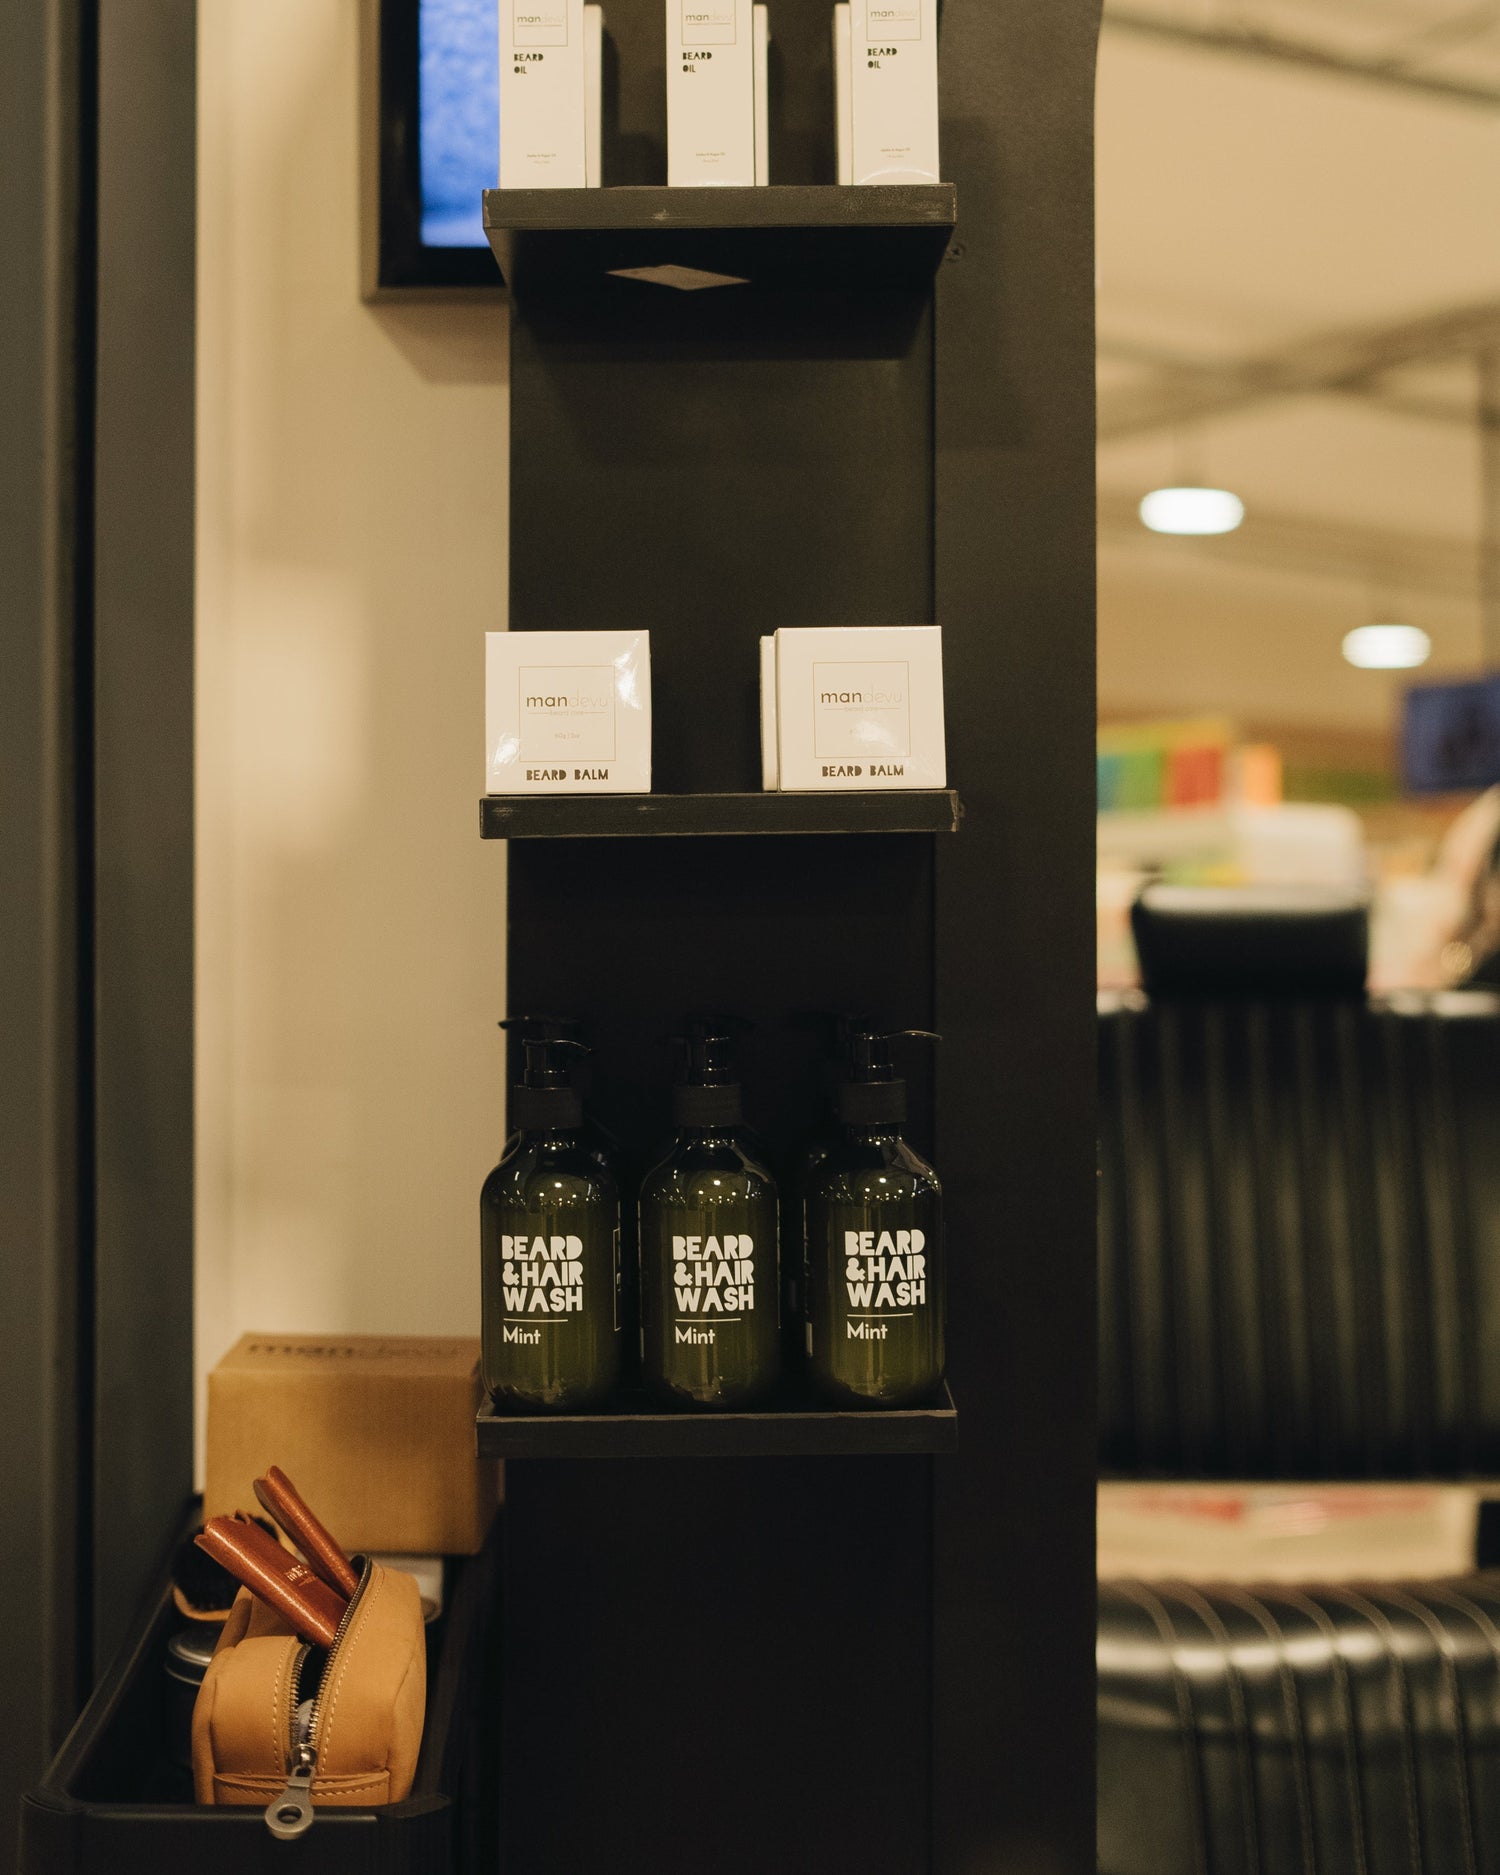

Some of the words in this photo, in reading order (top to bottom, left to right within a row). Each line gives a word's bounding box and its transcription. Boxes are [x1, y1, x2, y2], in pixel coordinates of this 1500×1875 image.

[513, 53, 544, 62] BEARD
[682, 51, 713, 61] BEARD
[868, 47, 898, 57] BEARD
[513, 65, 527, 75] OIL
[682, 64, 696, 73] OIL
[867, 60, 881, 69] OIL
[526, 688, 609, 708] mandevu
[820, 681, 903, 704] mandevu
[526, 769, 567, 781] BEARD
[574, 768, 609, 781] BALM
[821, 766, 862, 778] BEARD
[869, 764, 904, 777] BALM
[501, 1234, 583, 1260] BEARD
[672, 1234, 754, 1260] BEARD
[844, 1229, 926, 1255] BEARD
[502, 1287, 583, 1313] WASH
[673, 1287, 754, 1313] WASH
[845, 1282, 926, 1308] WASH
[503, 1325, 542, 1345] Mint
[675, 1326, 716, 1345] Mint
[846, 1321, 888, 1340] Mint
